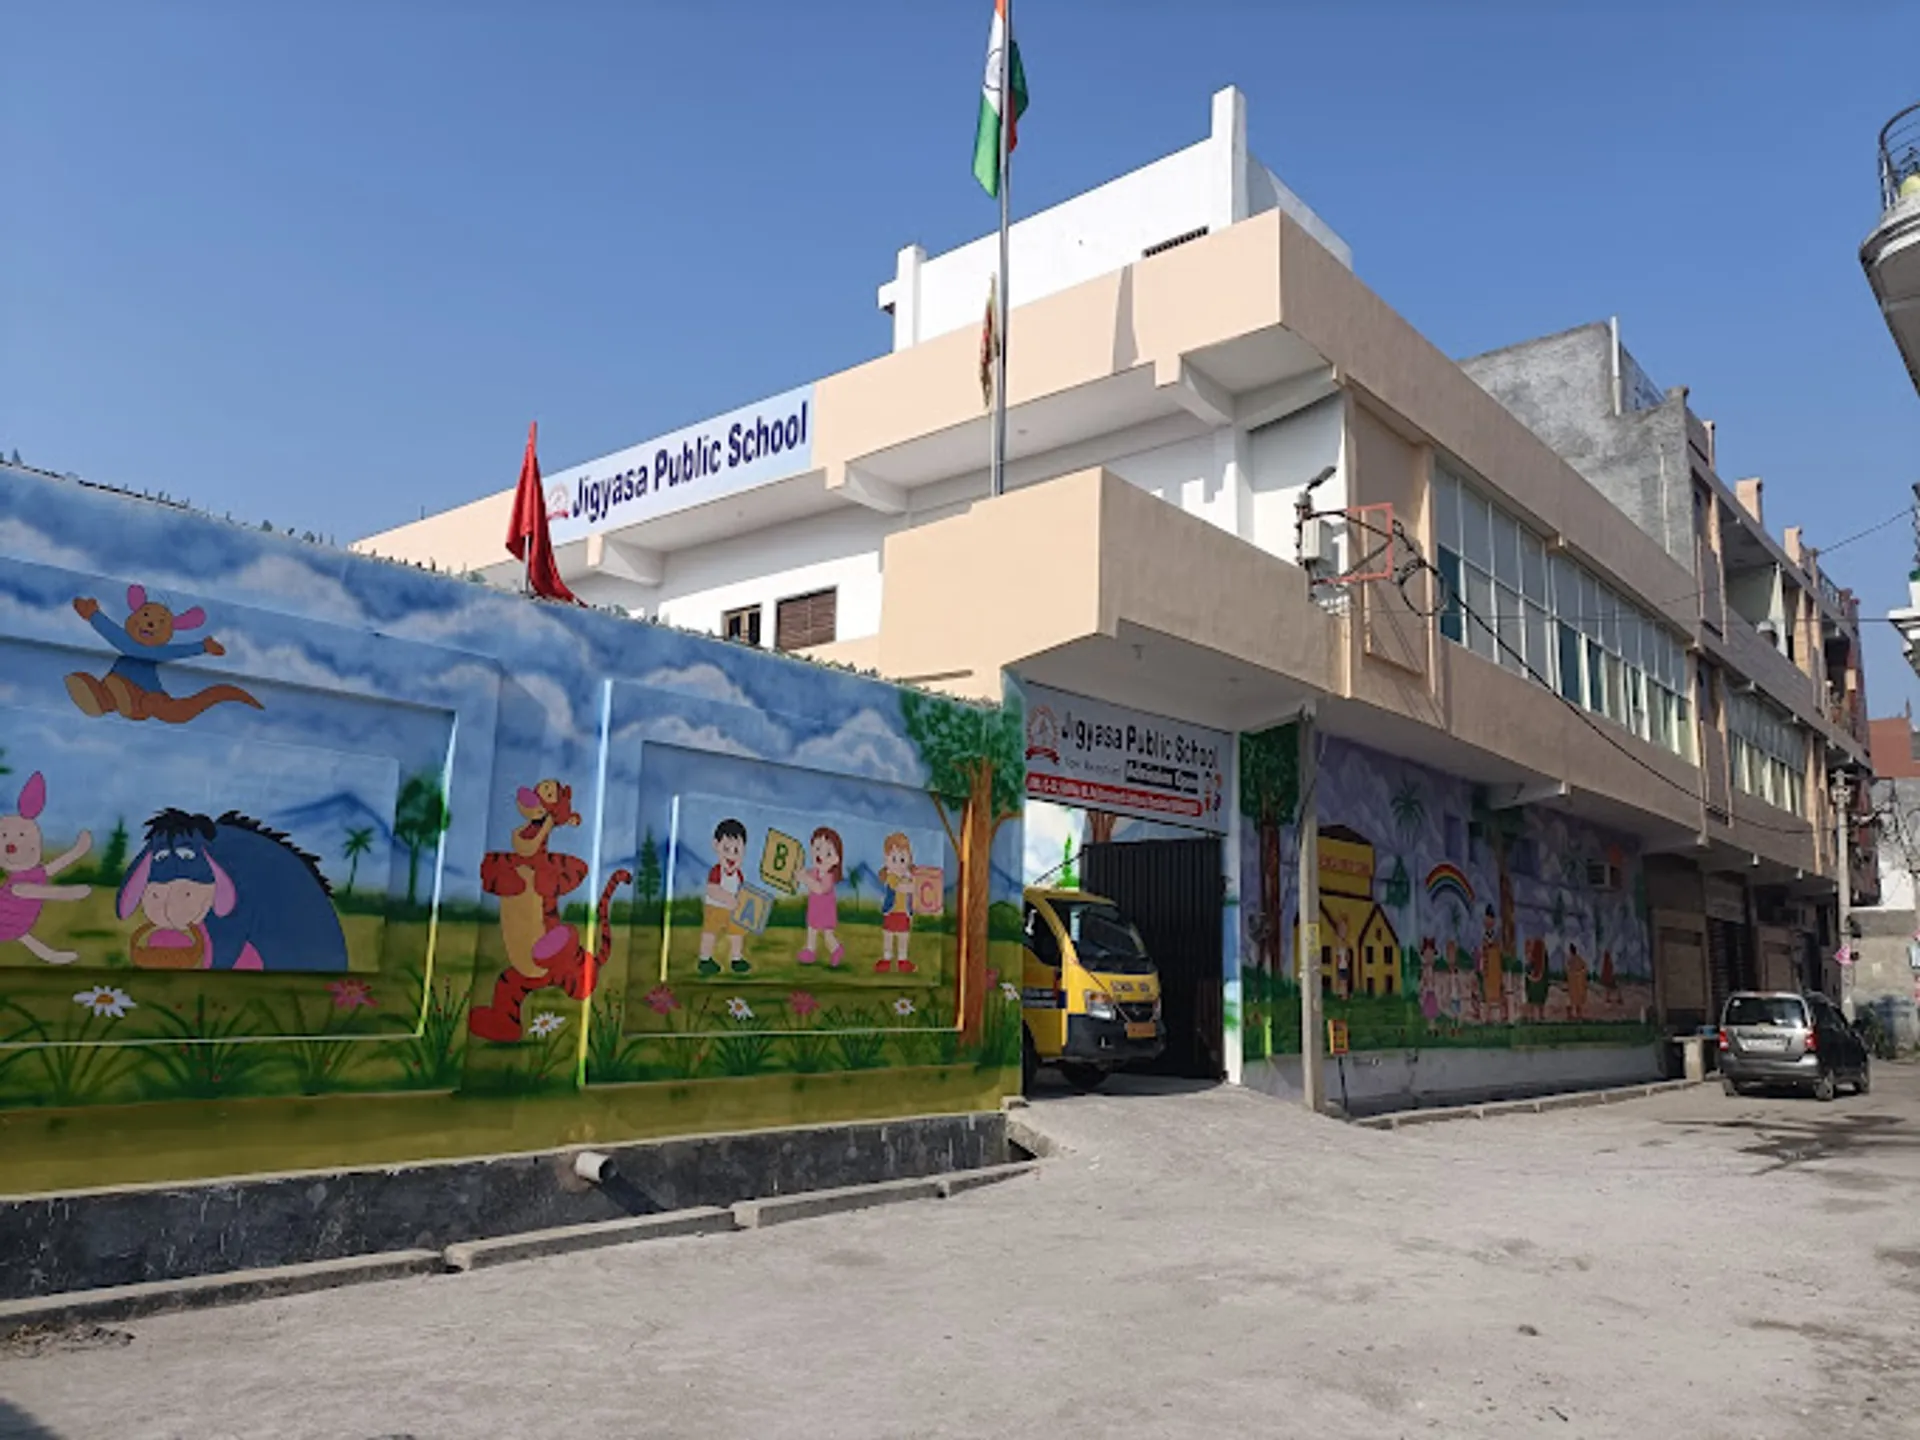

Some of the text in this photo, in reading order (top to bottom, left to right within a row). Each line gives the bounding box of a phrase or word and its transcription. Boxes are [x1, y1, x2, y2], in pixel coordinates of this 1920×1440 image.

[573, 401, 807, 523] Jigyasa Public School
[1061, 711, 1219, 769] Jigyasa Public School
[773, 843, 789, 871] B
[920, 881, 936, 908] C
[740, 899, 755, 922] A
